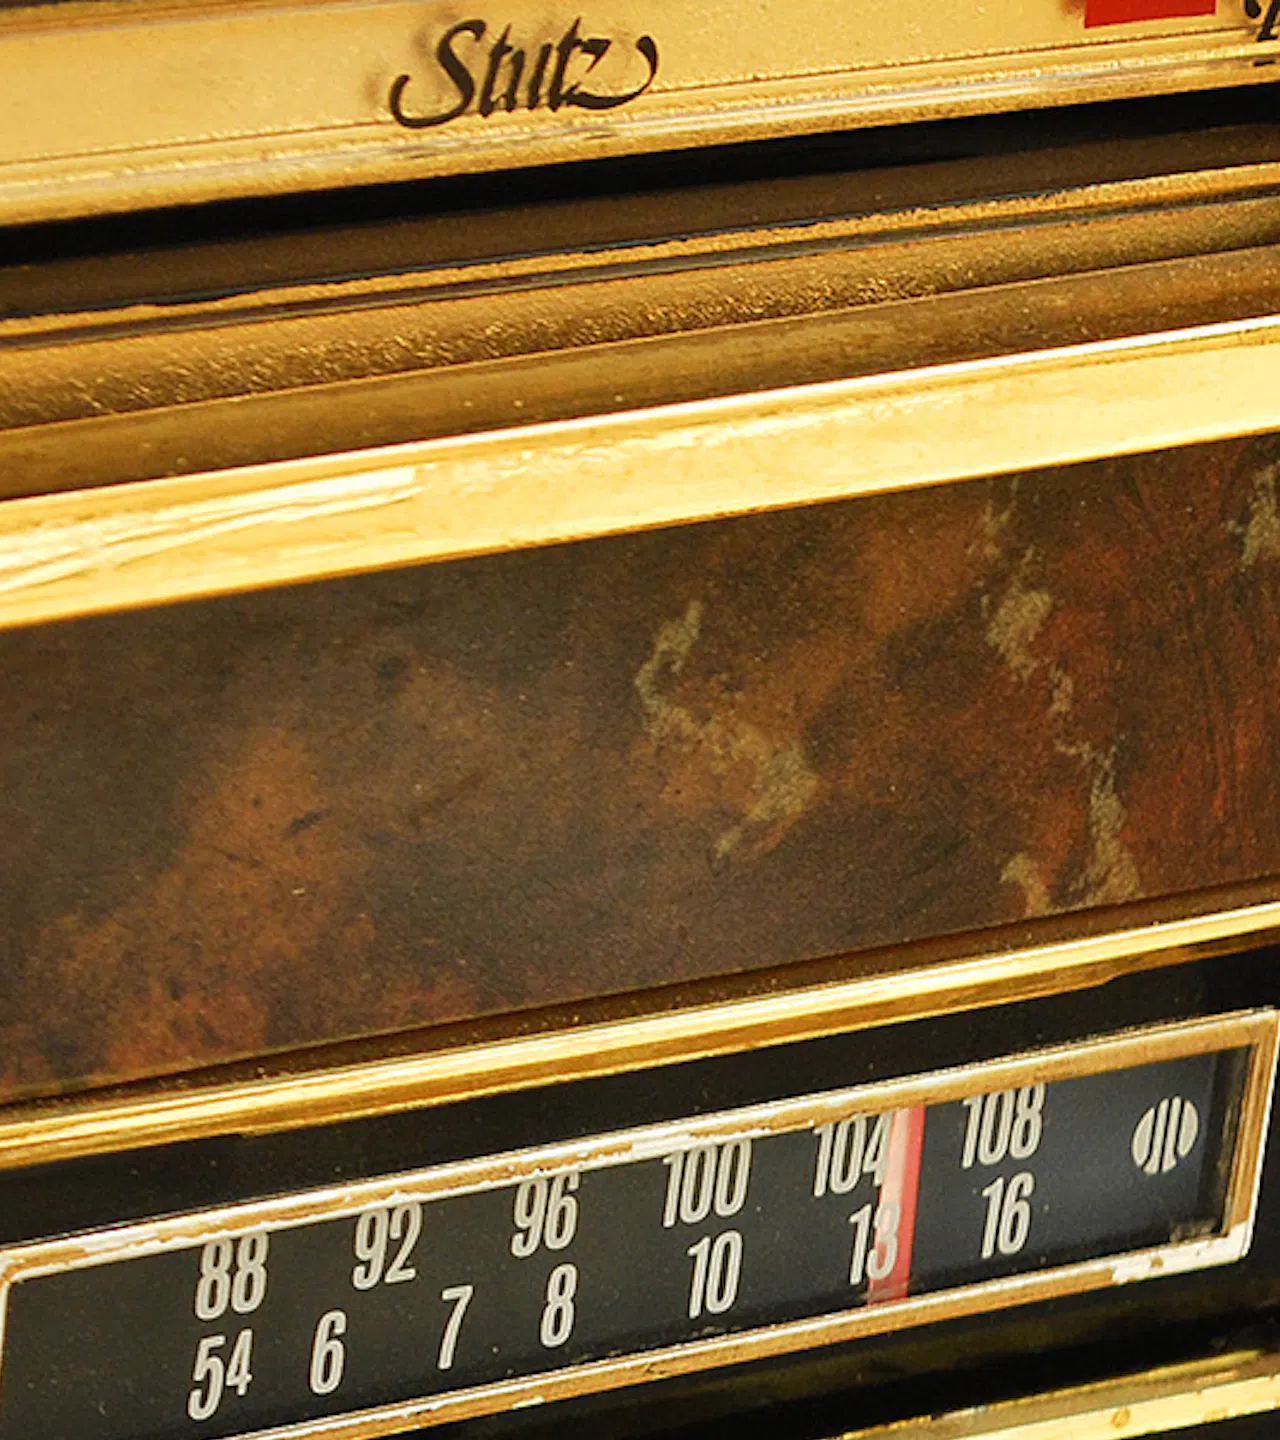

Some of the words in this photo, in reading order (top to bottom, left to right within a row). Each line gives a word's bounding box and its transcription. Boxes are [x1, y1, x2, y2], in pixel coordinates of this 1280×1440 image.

[388, 16, 658, 129] Stutz
[188, 1328, 254, 1421] 54
[308, 1309, 347, 1395] 6
[437, 1284, 474, 1370] 7
[540, 1263, 578, 1349] 8
[687, 1230, 743, 1319] 10
[848, 1201, 900, 1286] 13
[981, 1172, 1035, 1259] 16
[194, 1231, 269, 1321] 88
[351, 1202, 423, 1290] 92
[510, 1170, 580, 1257] 96
[661, 1139, 752, 1228] 100
[812, 1111, 892, 1197] 104
[961, 1082, 1048, 1169] 108
